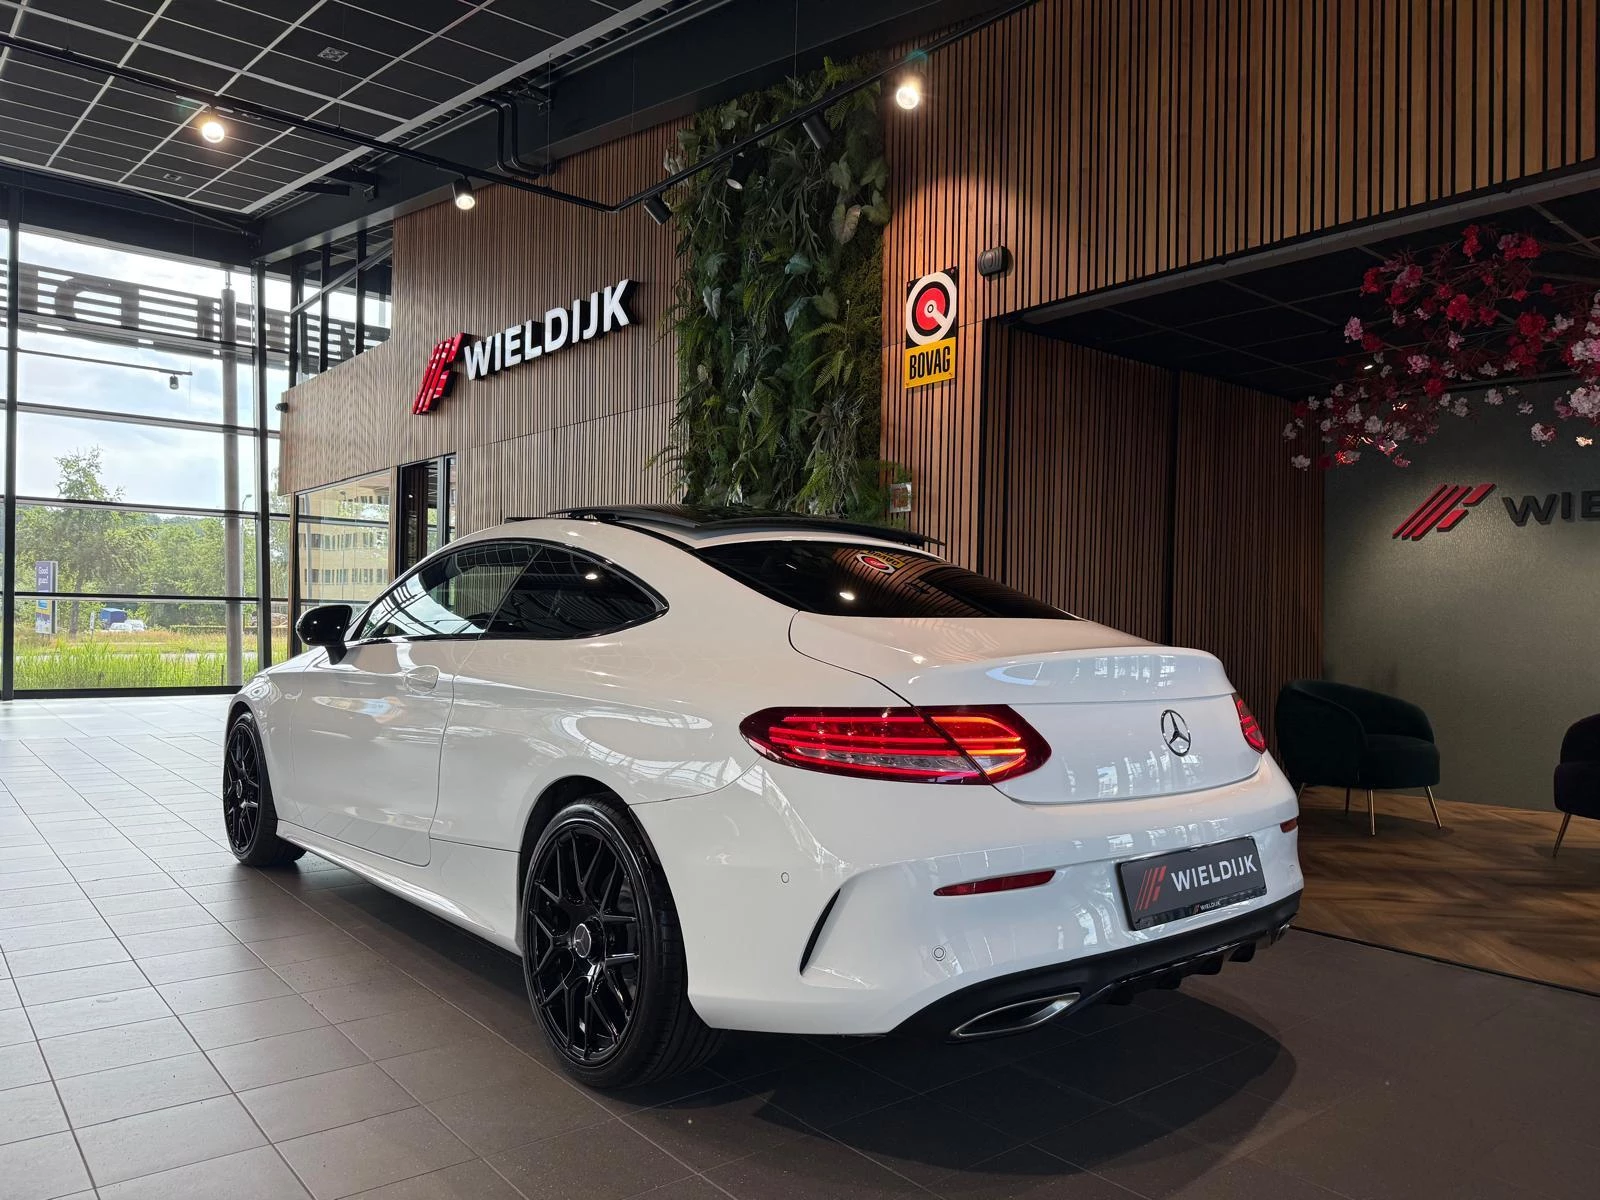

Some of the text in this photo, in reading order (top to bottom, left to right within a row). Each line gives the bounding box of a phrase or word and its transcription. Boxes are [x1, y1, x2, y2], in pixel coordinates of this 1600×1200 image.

[463, 279, 631, 381] WIELDIJK
[909, 345, 951, 379] BOVAG
[1502, 490, 1600, 527] WIE
[1171, 855, 1258, 892] WIELDIJK
[1200, 900, 1221, 911] WIELDIJK
